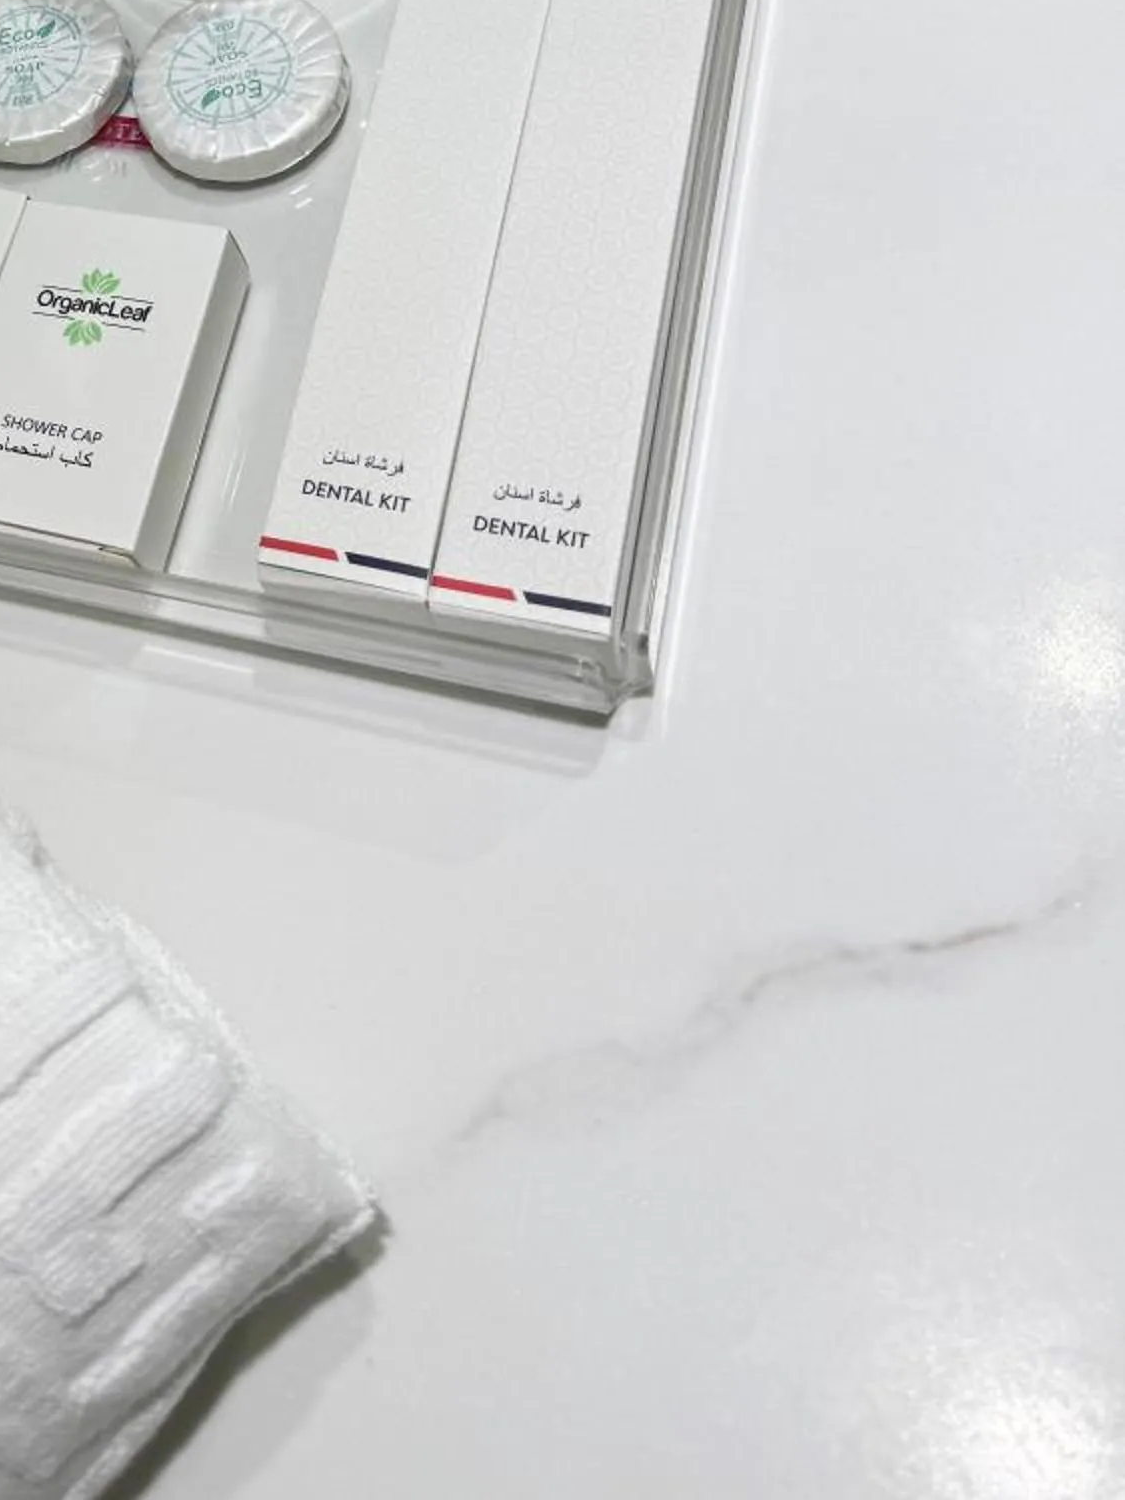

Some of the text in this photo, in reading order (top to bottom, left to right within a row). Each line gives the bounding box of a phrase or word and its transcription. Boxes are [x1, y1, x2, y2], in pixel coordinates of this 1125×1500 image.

[0, 27, 34, 45] Eco
[222, 79, 262, 99] Eco
[36, 289, 153, 323] OrganicLeaf
[0, 413, 103, 445] SHOWER CAP
[302, 479, 412, 513] DENTAL KIT
[472, 515, 591, 549] DENTAL KIT
